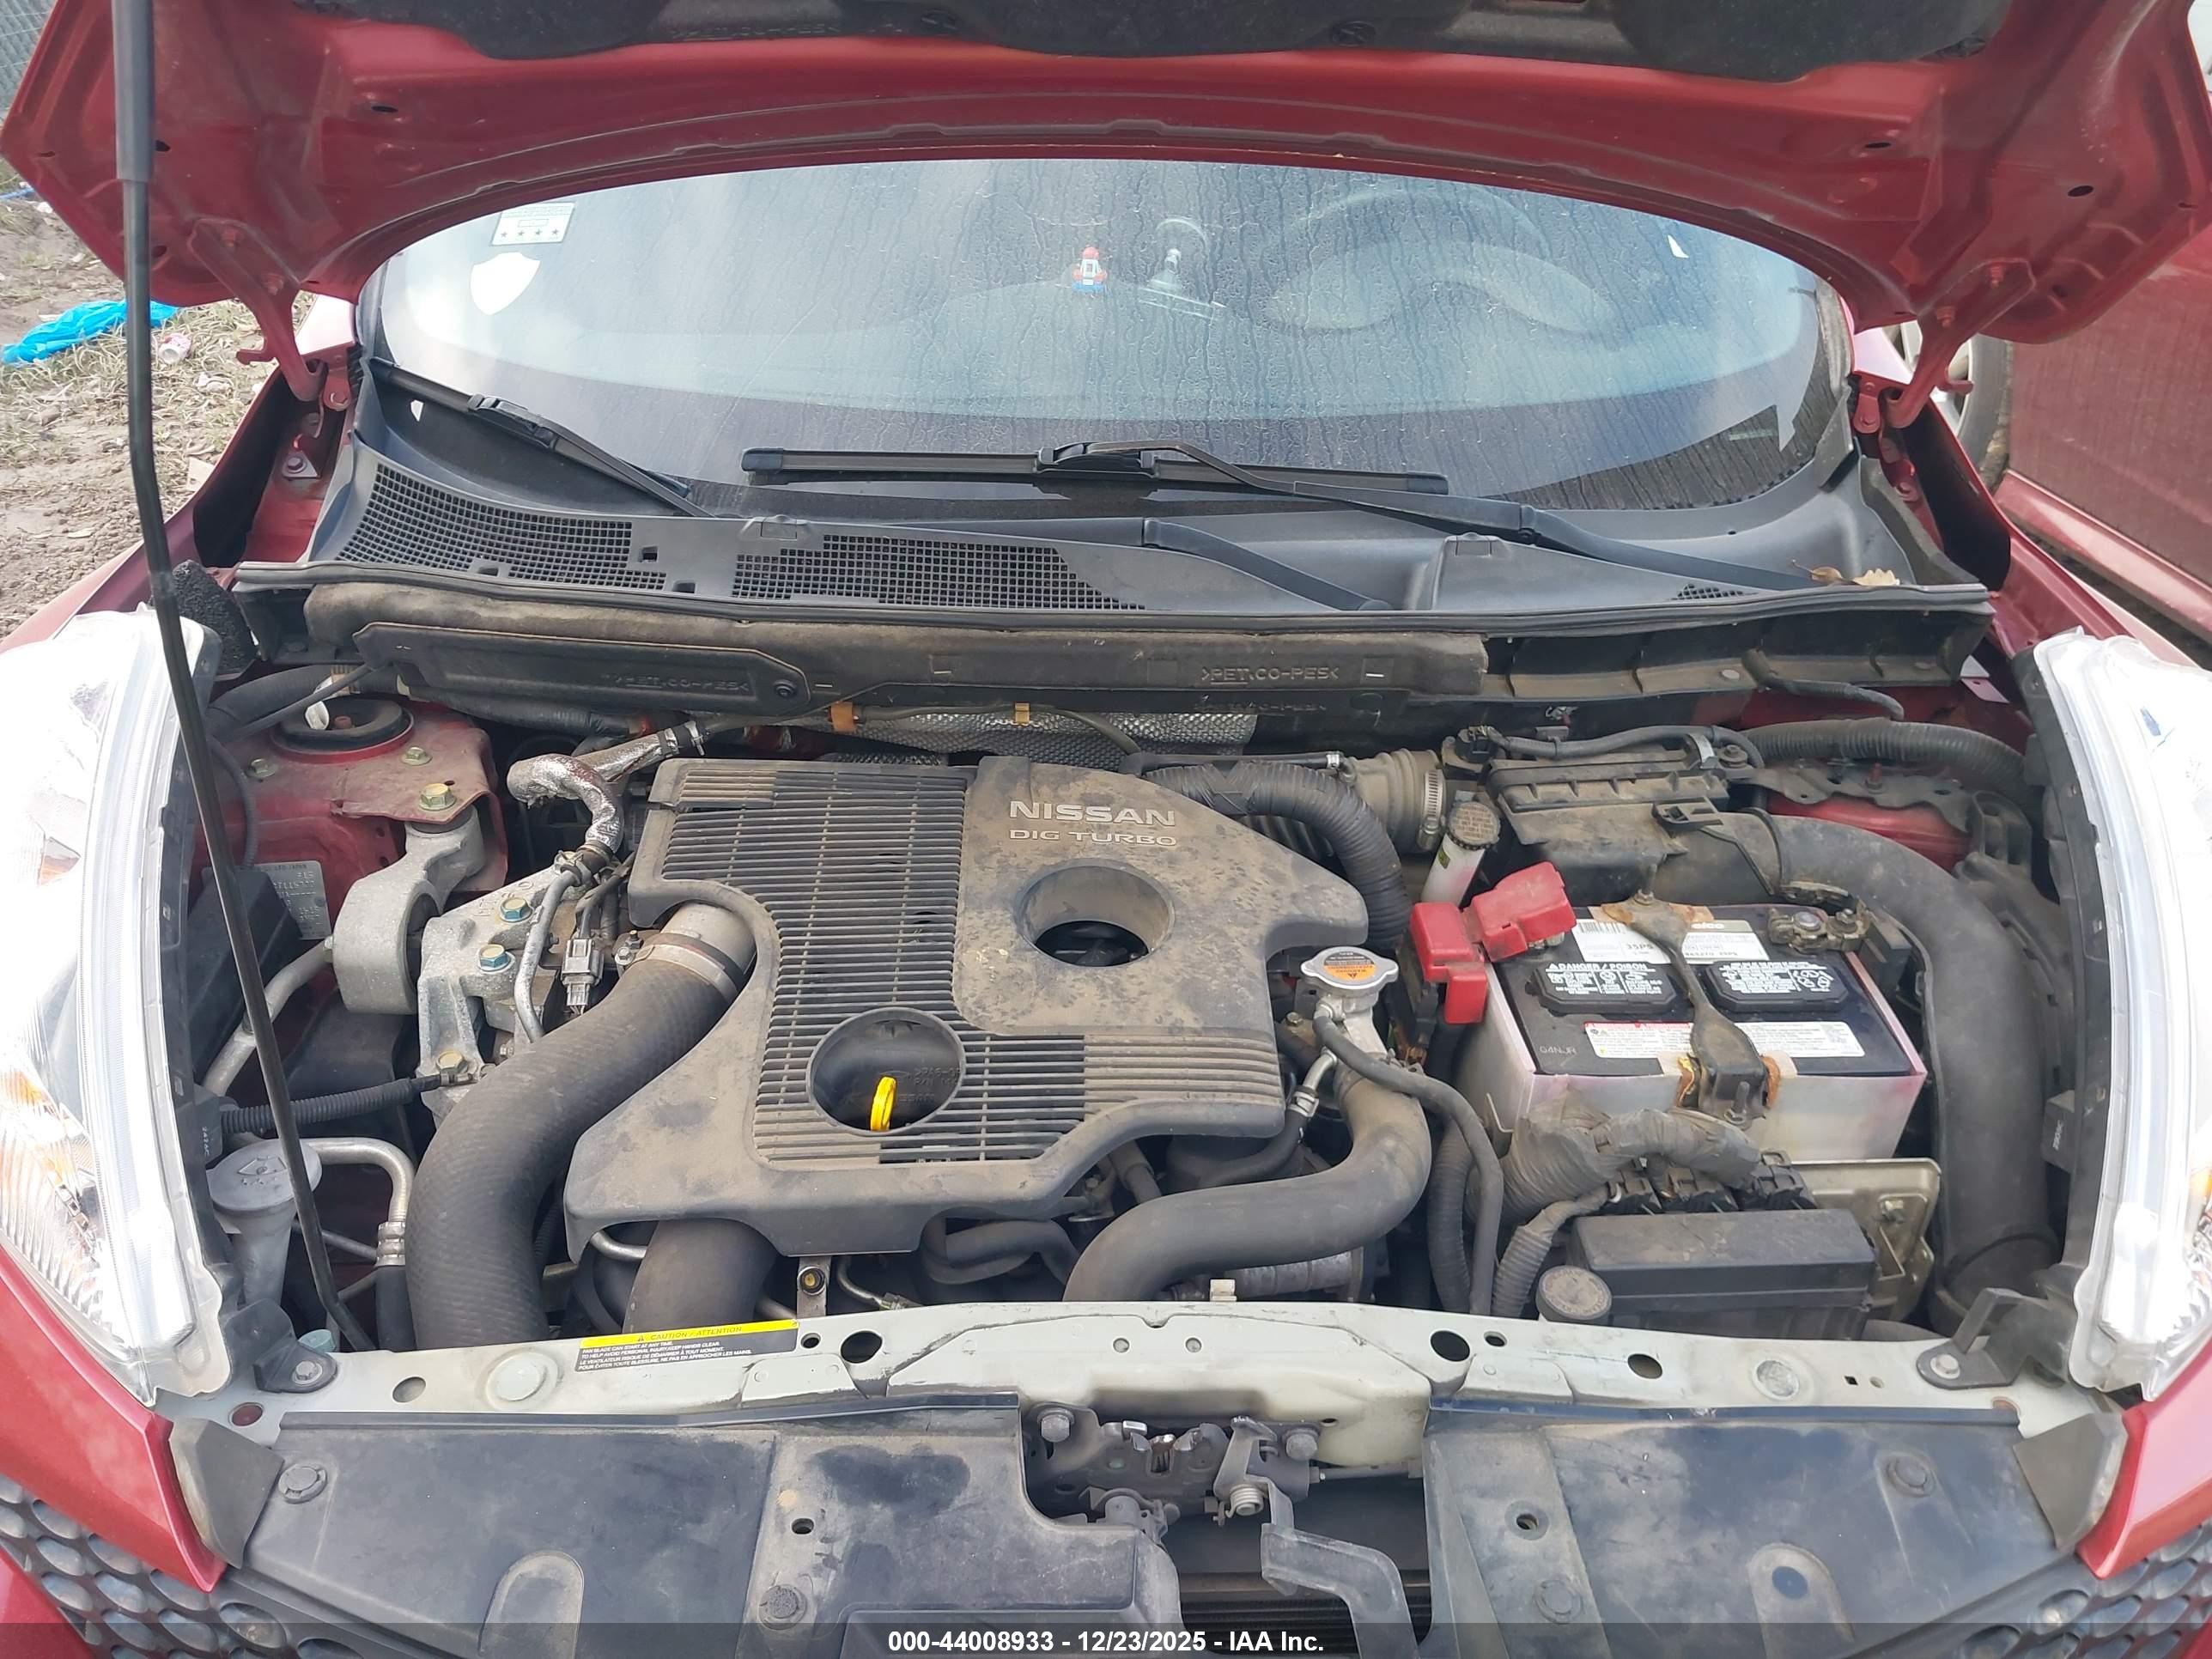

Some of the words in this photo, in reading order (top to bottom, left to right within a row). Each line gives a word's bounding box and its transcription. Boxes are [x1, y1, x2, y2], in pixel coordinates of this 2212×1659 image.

[1009, 800, 1176, 826] NISSAN
[1009, 830, 1060, 841] DIG
[1067, 831, 1177, 846] TURBO
[650, 1332, 687, 1340] CAUTION
[696, 1327, 742, 1337] ATTENTION
[587, 1356, 622, 1364] VENTILATEUR
[689, 1352, 722, 1360] APPROCHER
